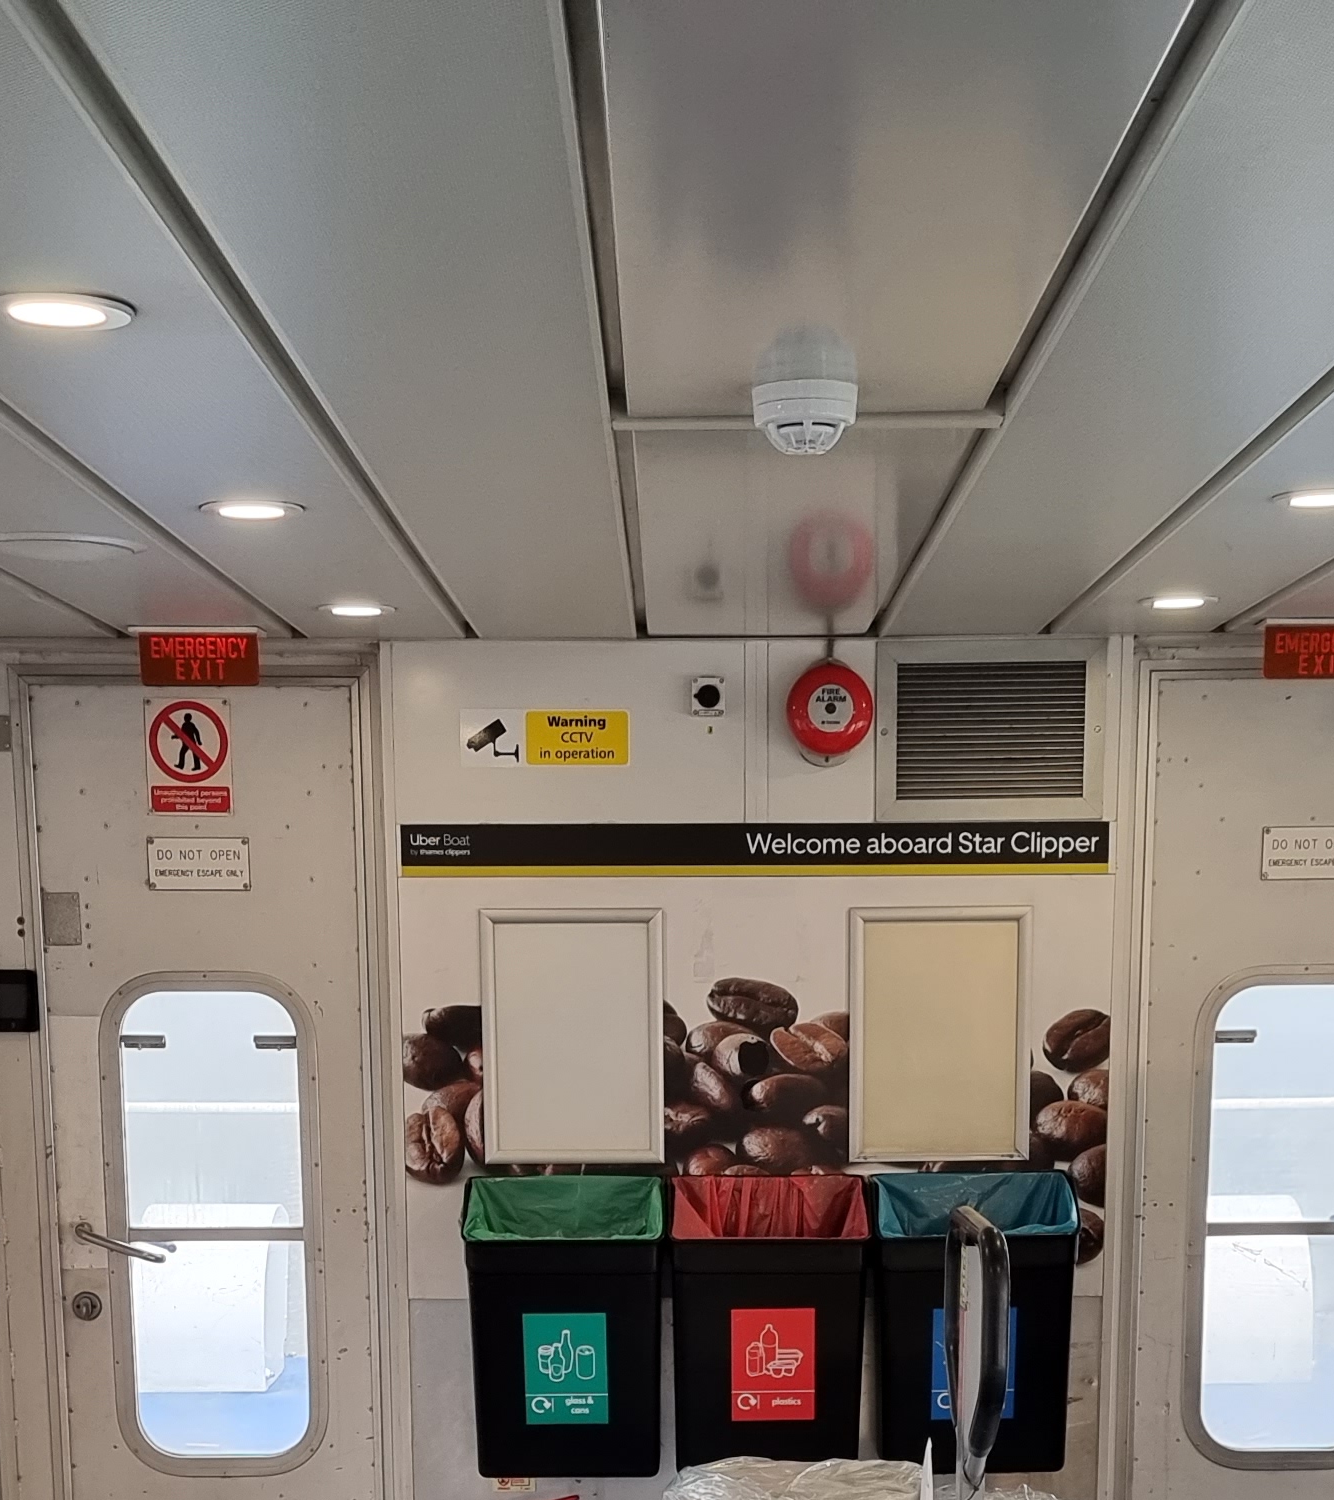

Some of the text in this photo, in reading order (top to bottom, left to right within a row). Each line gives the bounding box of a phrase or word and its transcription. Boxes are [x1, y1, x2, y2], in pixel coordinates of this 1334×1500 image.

[150, 636, 248, 658] EMERGENCY
[175, 659, 225, 680] EXIT
[821, 688, 841, 696] FIRE
[815, 695, 847, 703] ALARM
[547, 715, 607, 730] Warning
[560, 731, 594, 743] CCTV
[539, 747, 615, 762] in operation
[410, 833, 471, 846] Uber Boat
[746, 831, 1100, 859] Welcome aboard Star Clipper
[1272, 838, 1288, 850] DO
[1294, 838, 1319, 850] NOT
[156, 849, 241, 861] DO NOT OPEN
[1268, 858, 1308, 867] EMERGENCY
[154, 868, 244, 878] EMERGENCY ESCAPE ONLY
[565, 1395, 586, 1407] glass
[771, 1396, 802, 1408] plastics
[570, 1407, 590, 1415] cans
